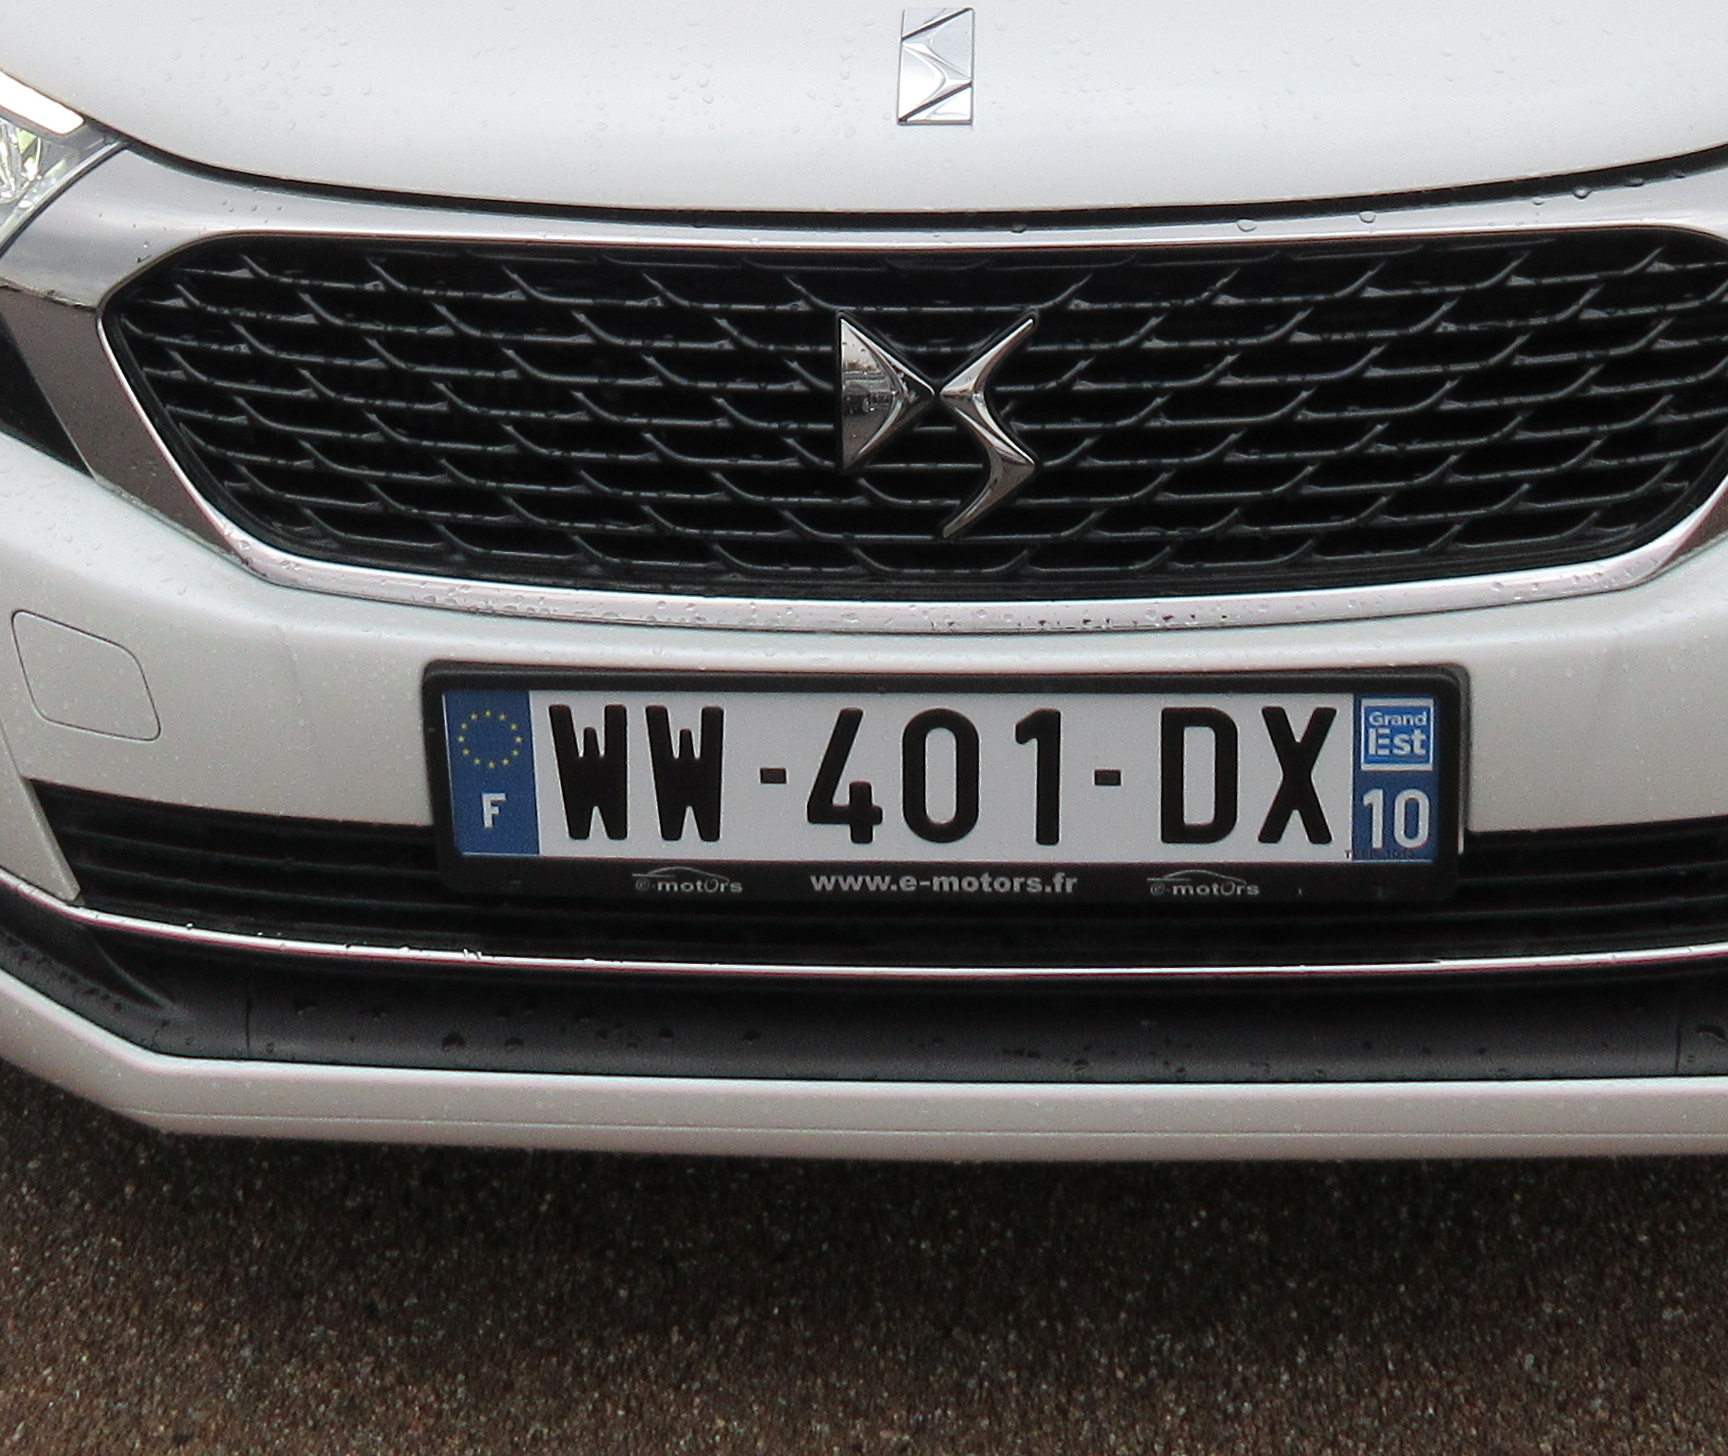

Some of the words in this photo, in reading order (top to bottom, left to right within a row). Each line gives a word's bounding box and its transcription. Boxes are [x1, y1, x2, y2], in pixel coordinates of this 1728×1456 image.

[1369, 711, 1428, 727] Grand
[1368, 728, 1427, 756] Est
[549, 704, 1338, 846] WW-401-DX
[482, 792, 506, 829] F
[1362, 788, 1430, 849] 10
[810, 872, 1078, 893] www.e-motors.fr
